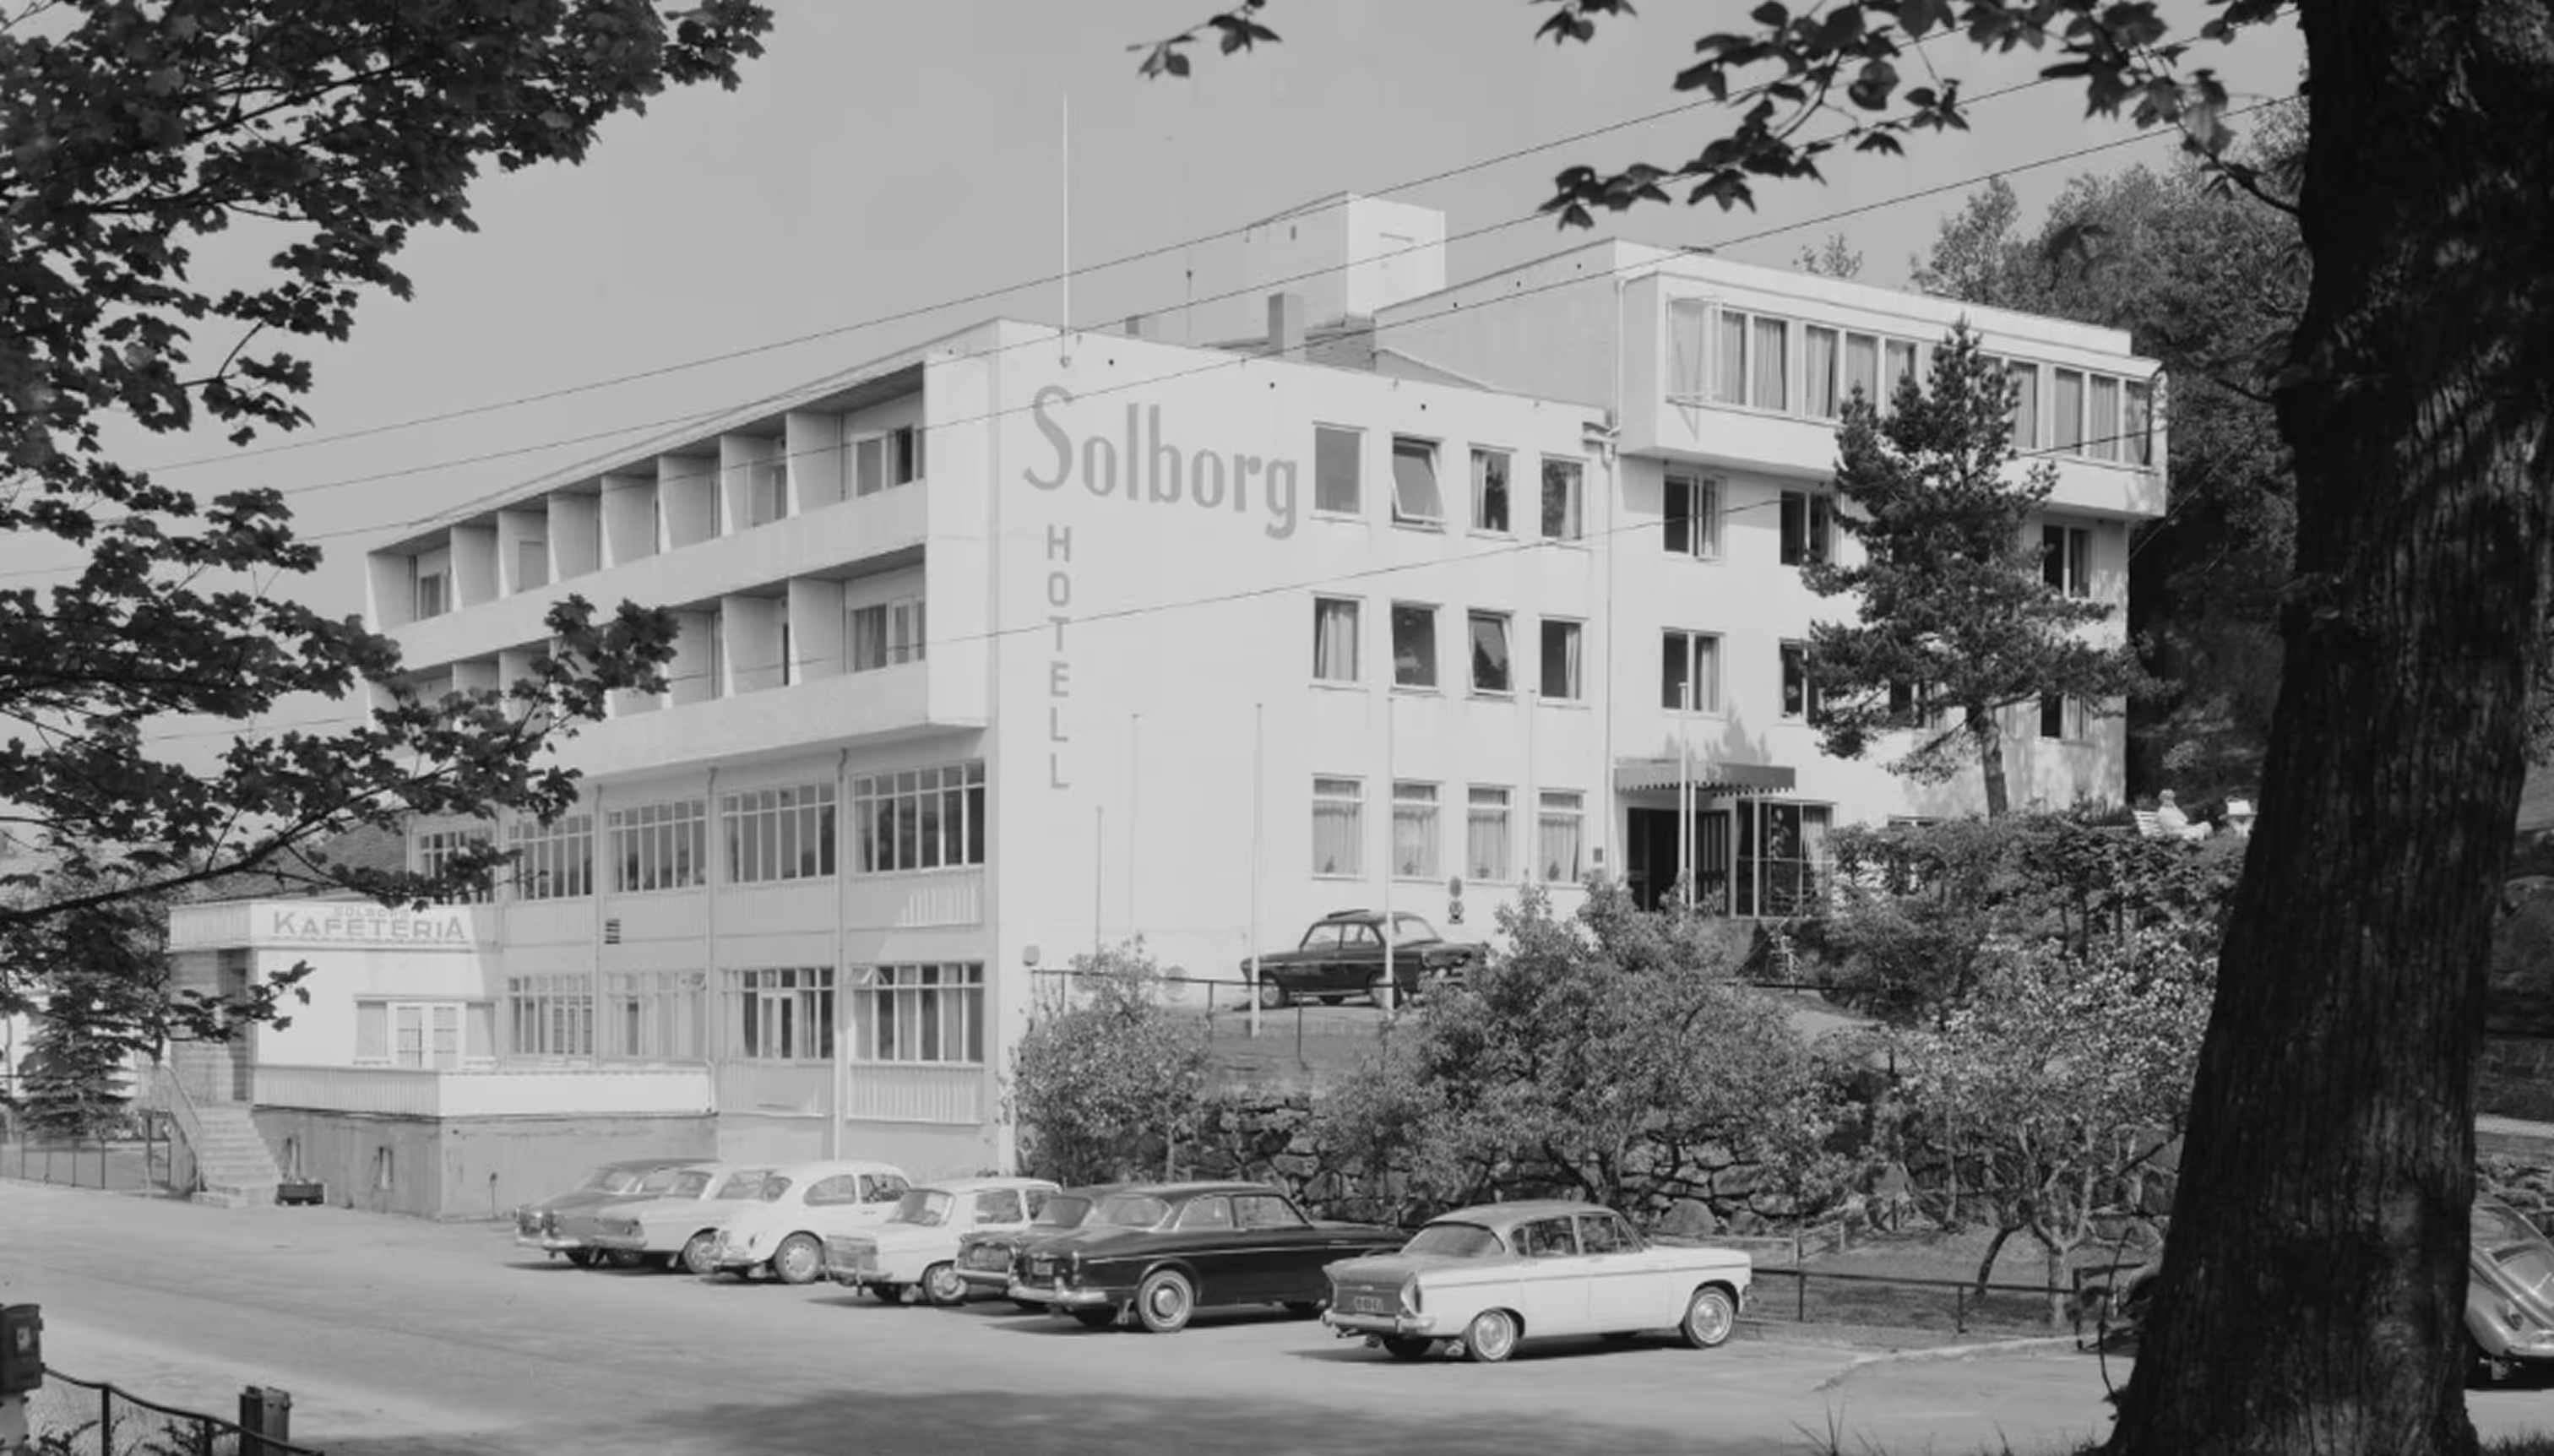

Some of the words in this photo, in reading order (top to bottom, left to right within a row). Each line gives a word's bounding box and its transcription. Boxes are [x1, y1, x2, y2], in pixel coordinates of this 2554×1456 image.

[1024, 385, 1297, 541] Solborg
[1047, 524, 1071, 790] HOTELL
[274, 910, 465, 940] KAFETERIA
